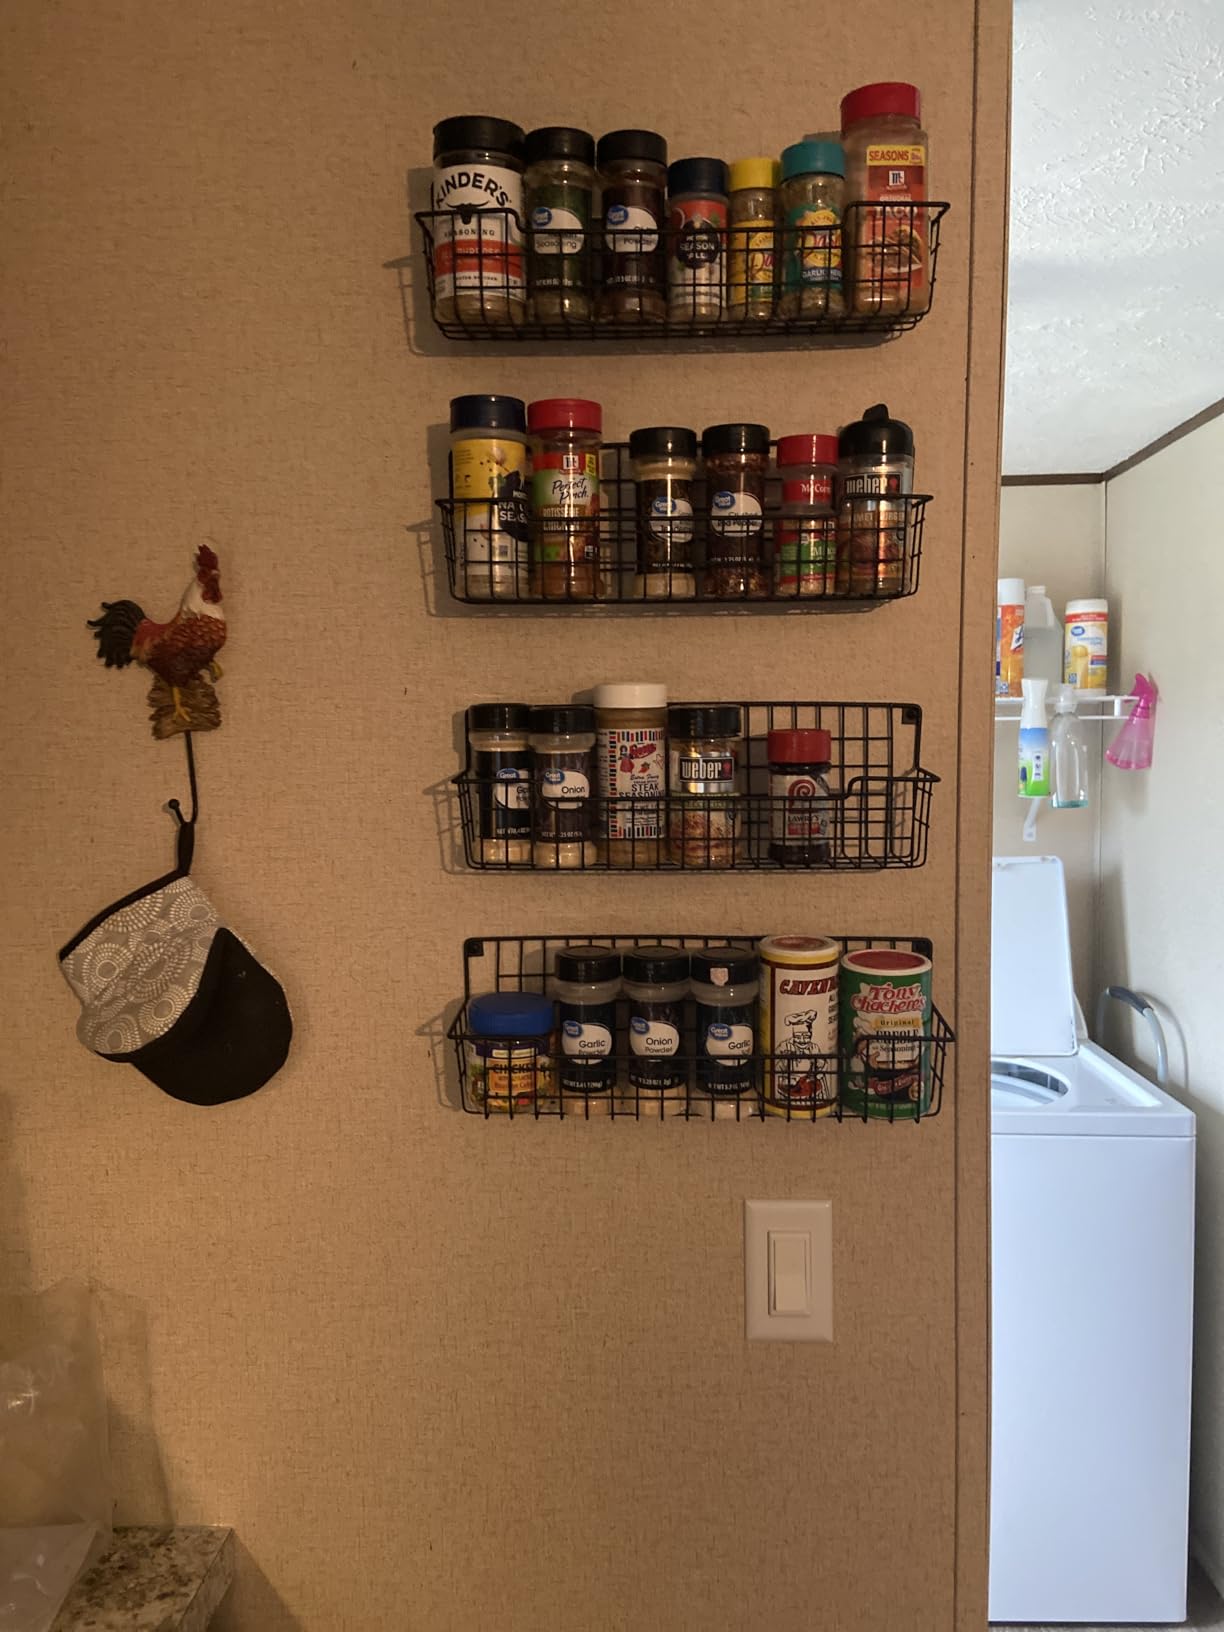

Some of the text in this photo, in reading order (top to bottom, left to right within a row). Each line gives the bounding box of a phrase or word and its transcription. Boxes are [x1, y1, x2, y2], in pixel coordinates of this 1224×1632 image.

[869, 150, 909, 161] SEASONS
[436, 172, 509, 208] KINDER'S
[846, 474, 888, 495] weber
[682, 758, 722, 779] weber
[561, 786, 585, 794] Onion
[632, 783, 659, 792] STEAK
[868, 983, 921, 1001] Tony
[880, 1018, 914, 1026] Original
[579, 1040, 606, 1048] Garlic
[646, 1037, 673, 1046] Onion
[728, 1039, 751, 1050] Garlic
